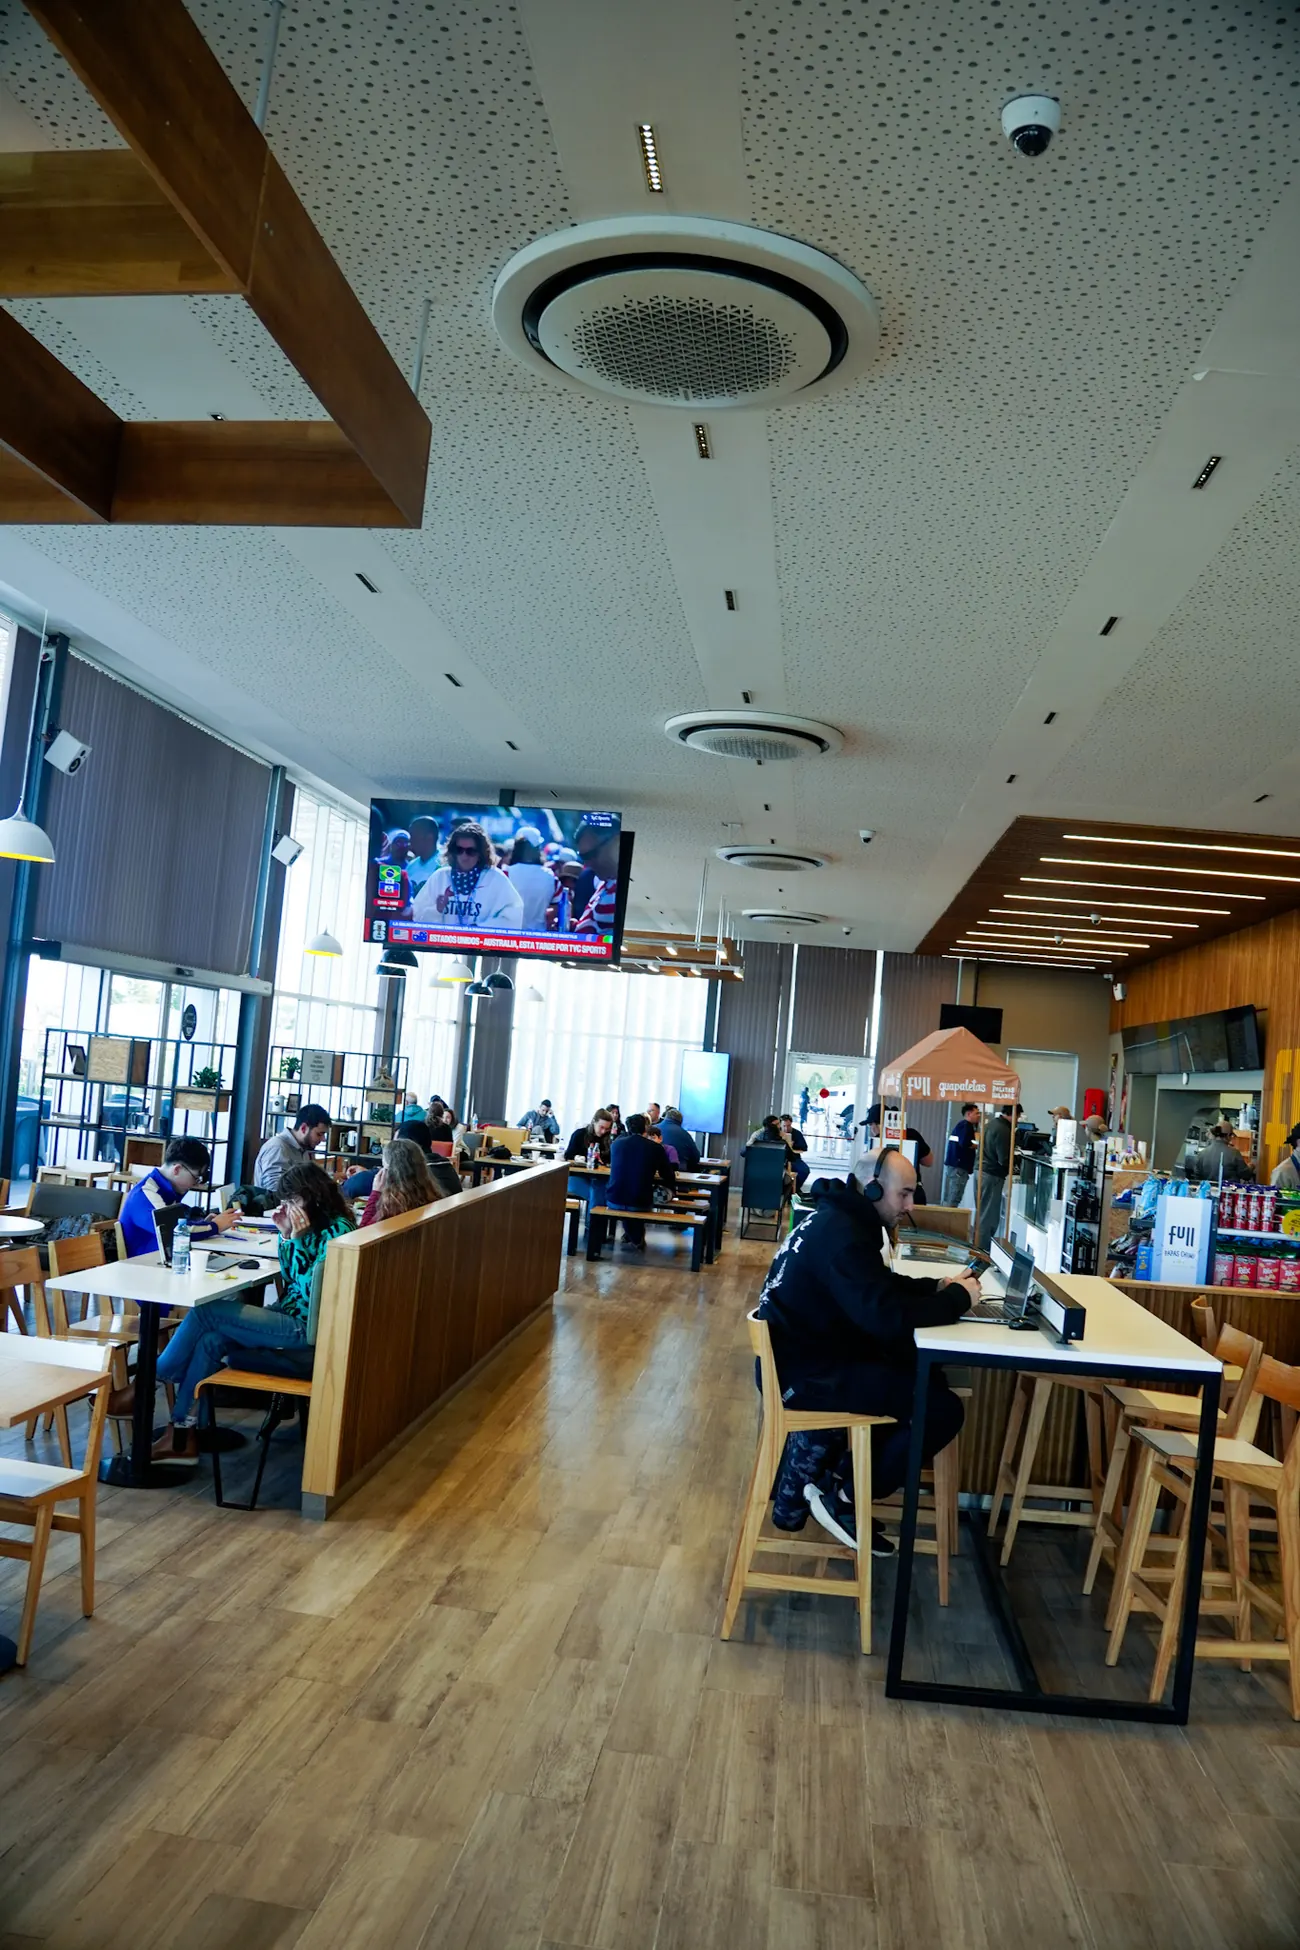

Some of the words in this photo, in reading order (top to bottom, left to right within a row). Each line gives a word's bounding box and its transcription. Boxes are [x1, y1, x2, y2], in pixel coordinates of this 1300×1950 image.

[429, 933, 456, 944] ESTADOS
[457, 935, 480, 945] UNIDOS
[483, 938, 518, 949] AUSTRALIA,
[519, 940, 535, 949] ESTA
[535, 942, 556, 951] TARDE
[556, 943, 568, 952] POR
[582, 945, 606, 955] SPORTS
[907, 1077, 930, 1096] full
[939, 1080, 986, 1098] guapaletas
[1169, 1226, 1194, 1247] full
